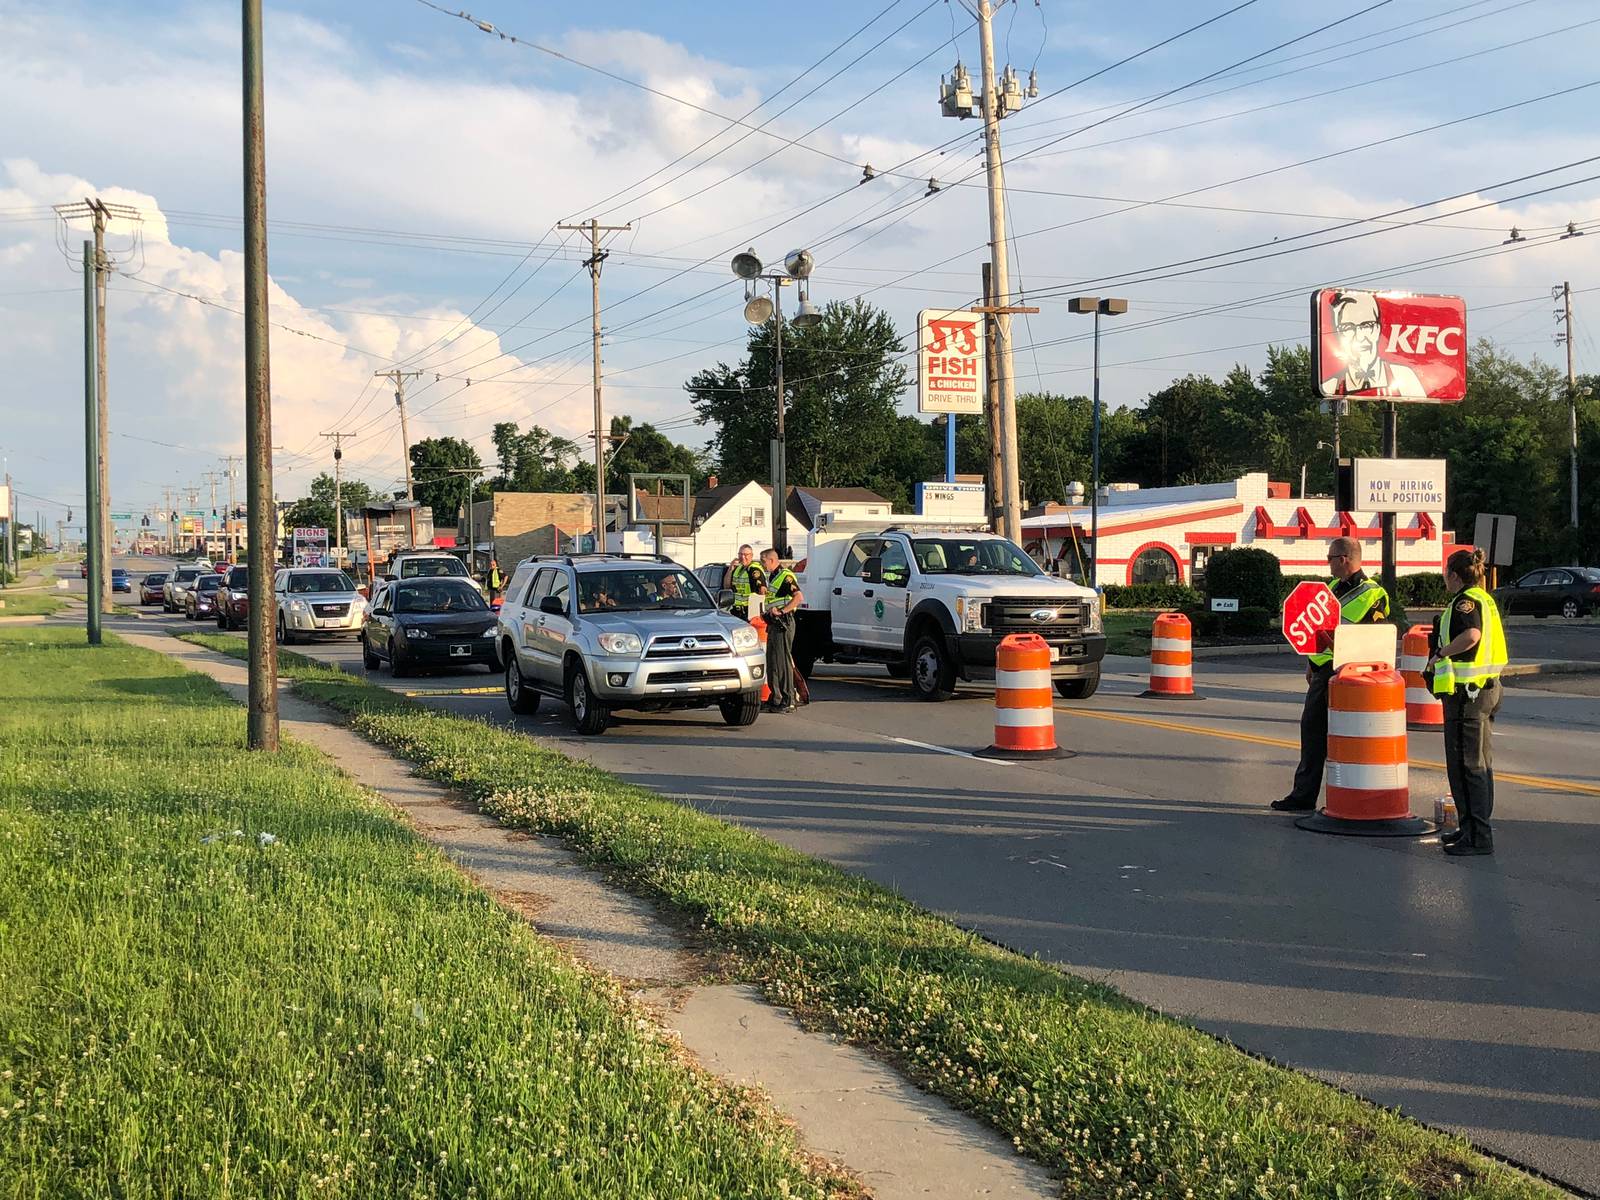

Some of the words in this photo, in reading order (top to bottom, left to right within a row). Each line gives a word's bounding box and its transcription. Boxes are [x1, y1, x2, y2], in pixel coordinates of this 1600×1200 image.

[1384, 324, 1461, 356] KFC
[928, 356, 977, 376] FISH
[928, 394, 952, 403] DRIVE
[956, 395, 977, 404] THRU
[1370, 480, 1391, 490] NOW
[1400, 480, 1433, 491] HIRING
[1370, 493, 1387, 502] ALL
[1393, 493, 1442, 502] POSITIONS
[296, 529, 325, 537] SIGNS
[1289, 590, 1331, 646] STOP
